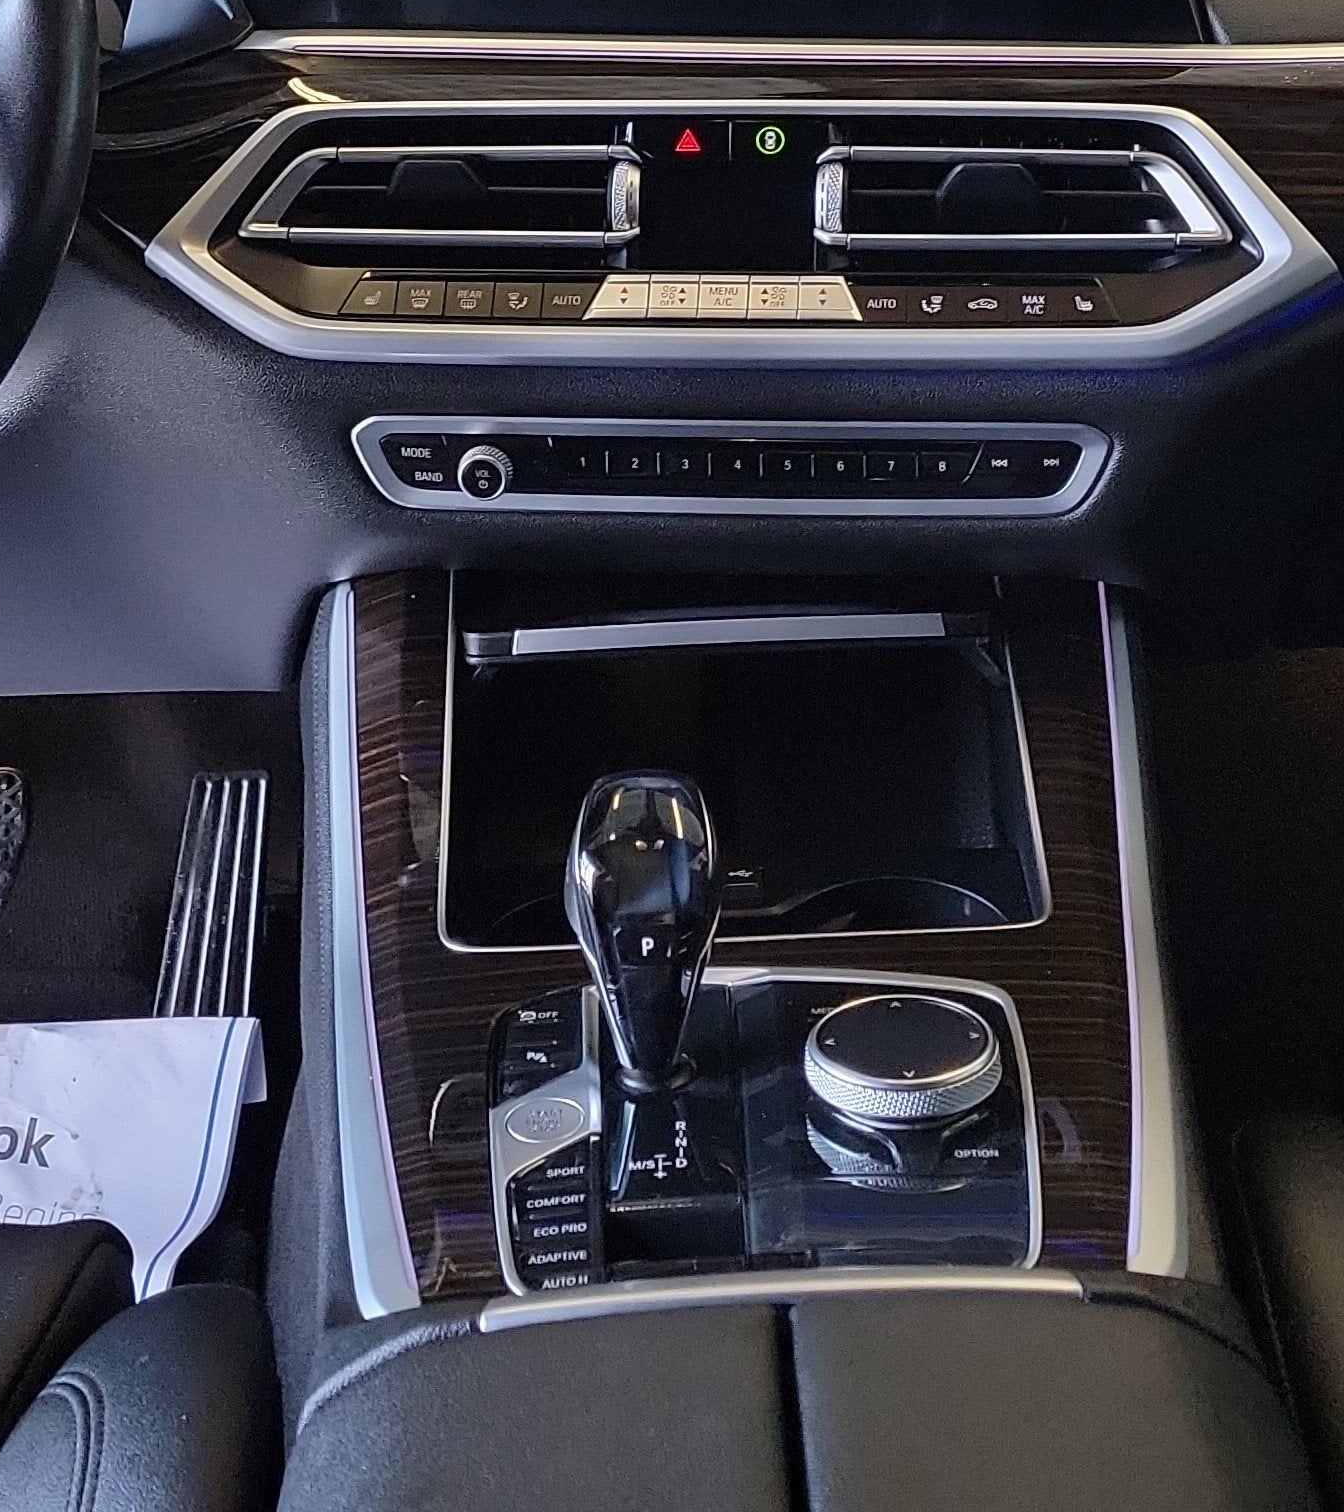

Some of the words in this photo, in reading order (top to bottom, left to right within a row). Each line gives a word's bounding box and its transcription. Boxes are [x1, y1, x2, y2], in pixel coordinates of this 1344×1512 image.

[410, 289, 432, 297] MAX
[457, 290, 483, 299] REAR
[709, 287, 738, 295] MENU
[552, 295, 581, 306] AUTO
[714, 298, 732, 307] A/C
[866, 298, 897, 309] AUTO
[1022, 295, 1046, 304] MAX
[1024, 305, 1045, 315] A/C
[401, 447, 432, 459] MODE
[579, 457, 586, 467] 1
[631, 458, 639, 469] 2
[681, 459, 689, 470] 3
[733, 460, 741, 470] 4
[784, 460, 792, 471] 5
[837, 461, 845, 472] 6
[887, 461, 895, 472] 7
[938, 461, 947, 472] 8
[414, 471, 443, 483] BAND
[475, 470, 491, 478] VOL
[642, 938, 654, 957] P
[675, 1121, 686, 1130] R
[675, 1137, 687, 1147] N
[954, 1148, 999, 1159] OPTION
[676, 1159, 688, 1168] D
[546, 1165, 585, 1178] SPORT
[526, 1194, 586, 1209] COMFORT
[533, 1226, 559, 1238] ECO
[561, 1223, 587, 1234] PRO
[527, 1249, 588, 1265] ADAPTIVE
[542, 1276, 576, 1290] AUTO
